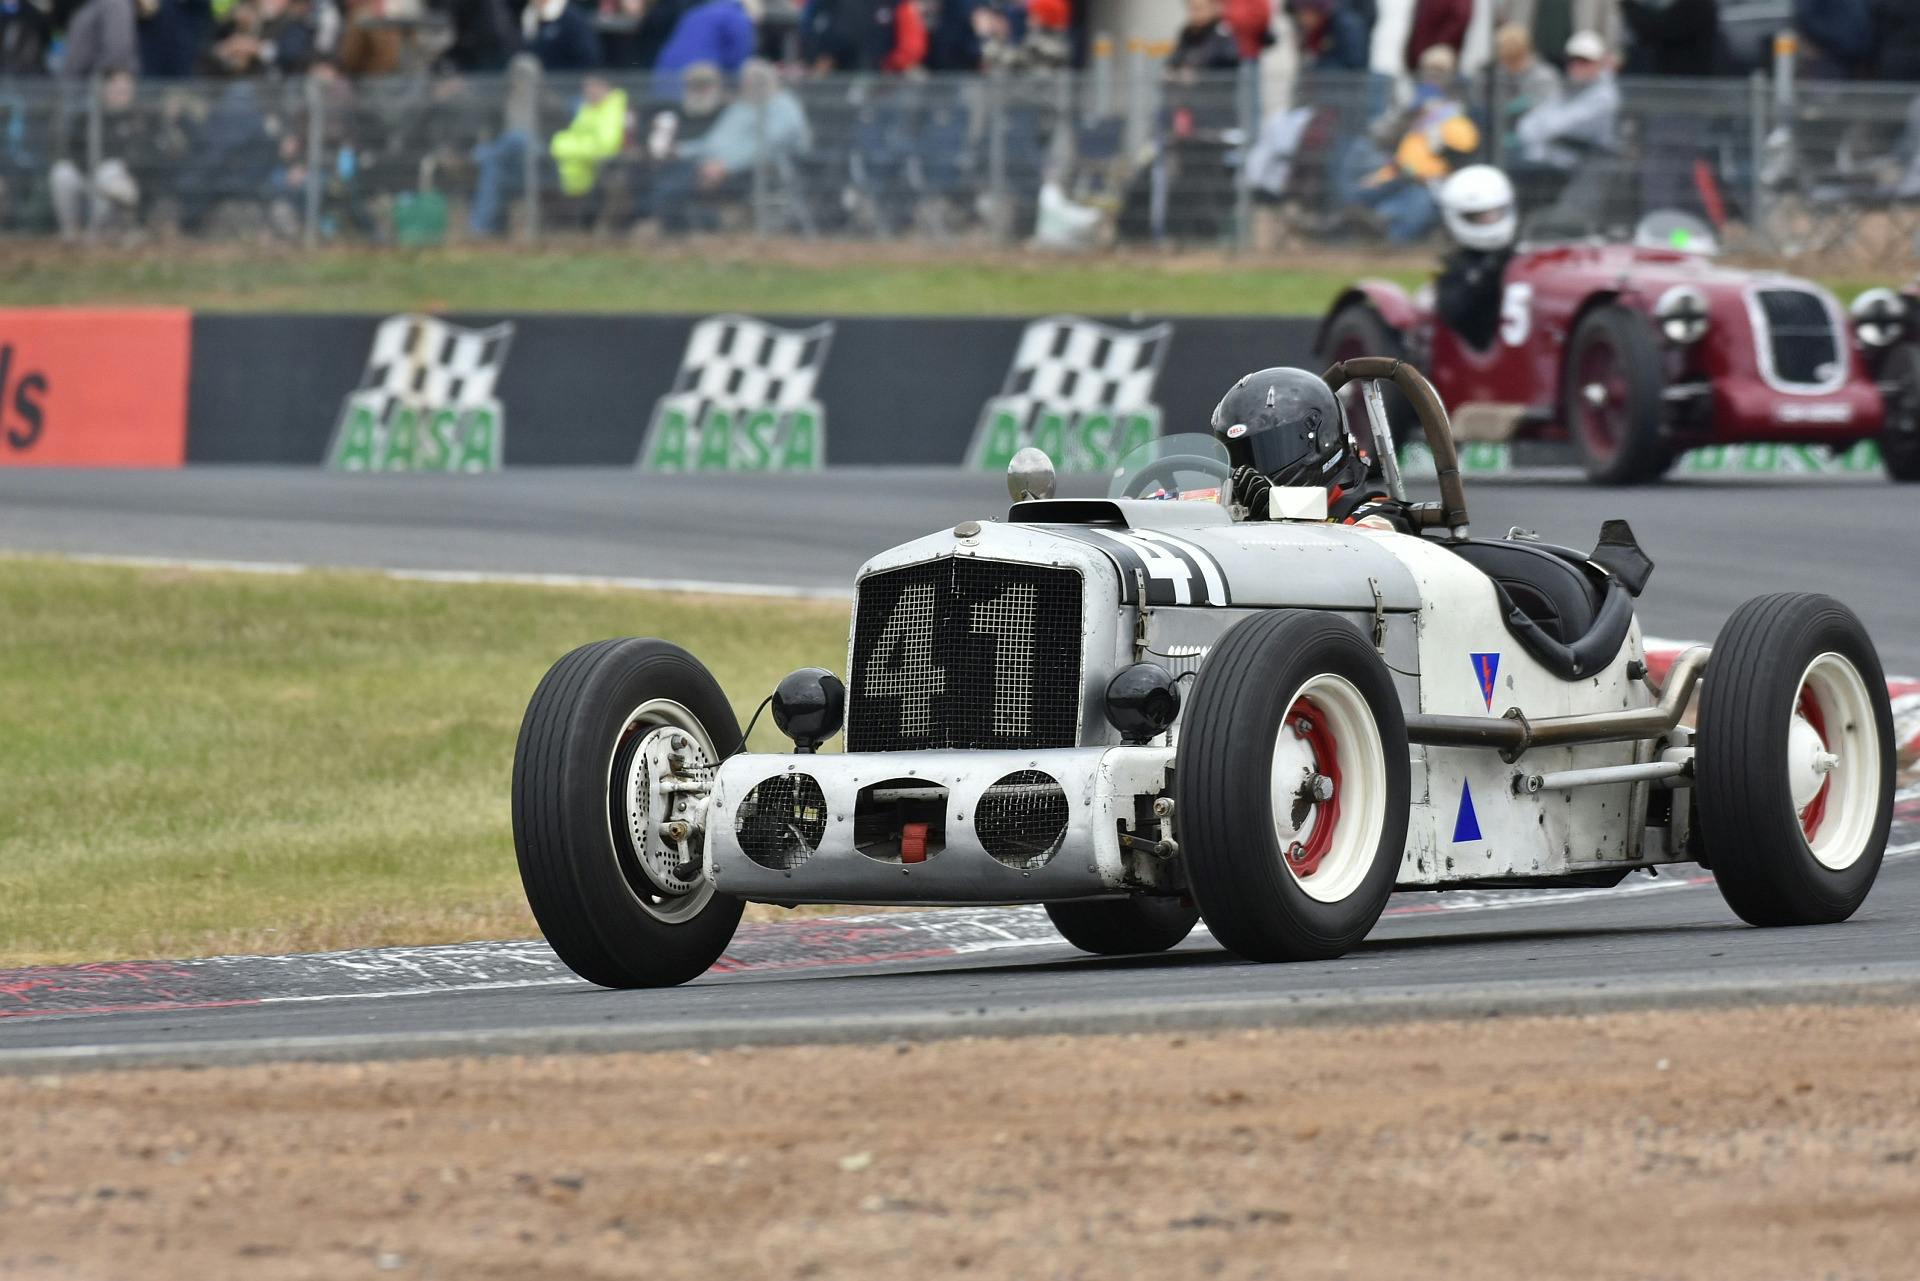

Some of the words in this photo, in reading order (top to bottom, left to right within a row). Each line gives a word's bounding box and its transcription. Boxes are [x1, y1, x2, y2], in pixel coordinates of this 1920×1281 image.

[336, 406, 497, 471] AASA
[648, 406, 820, 472] AASA
[1089, 528, 1228, 606] 41
[864, 583, 1039, 738] 41
